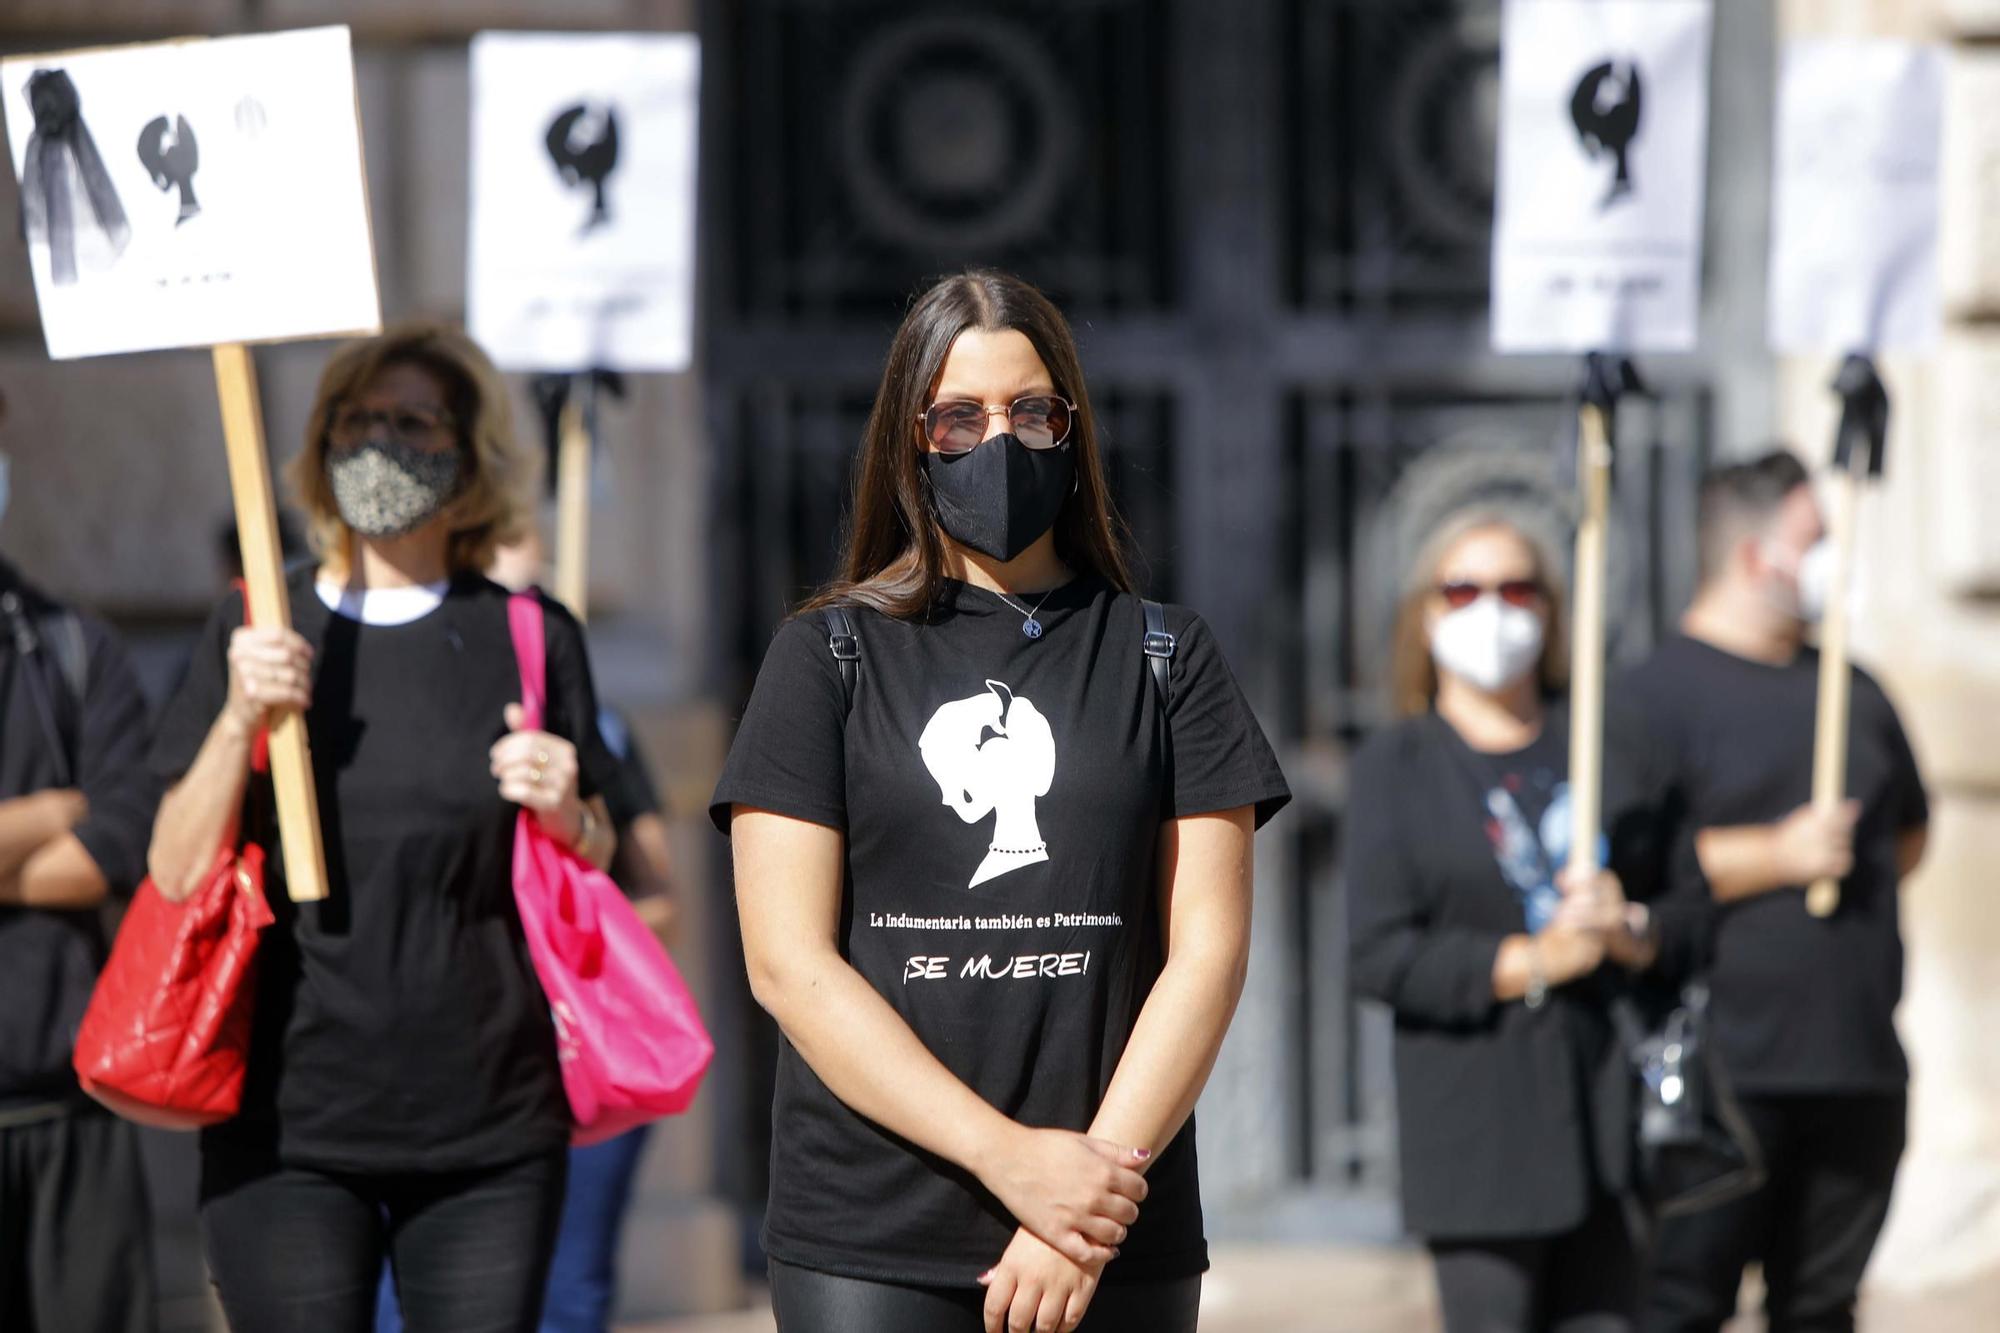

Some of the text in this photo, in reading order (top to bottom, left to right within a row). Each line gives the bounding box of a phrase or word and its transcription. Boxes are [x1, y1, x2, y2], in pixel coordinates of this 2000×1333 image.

[870, 912, 1123, 930] La Indumentaria también es Patrimonio.
[903, 950, 1090, 985] ¡SE MUERE!
